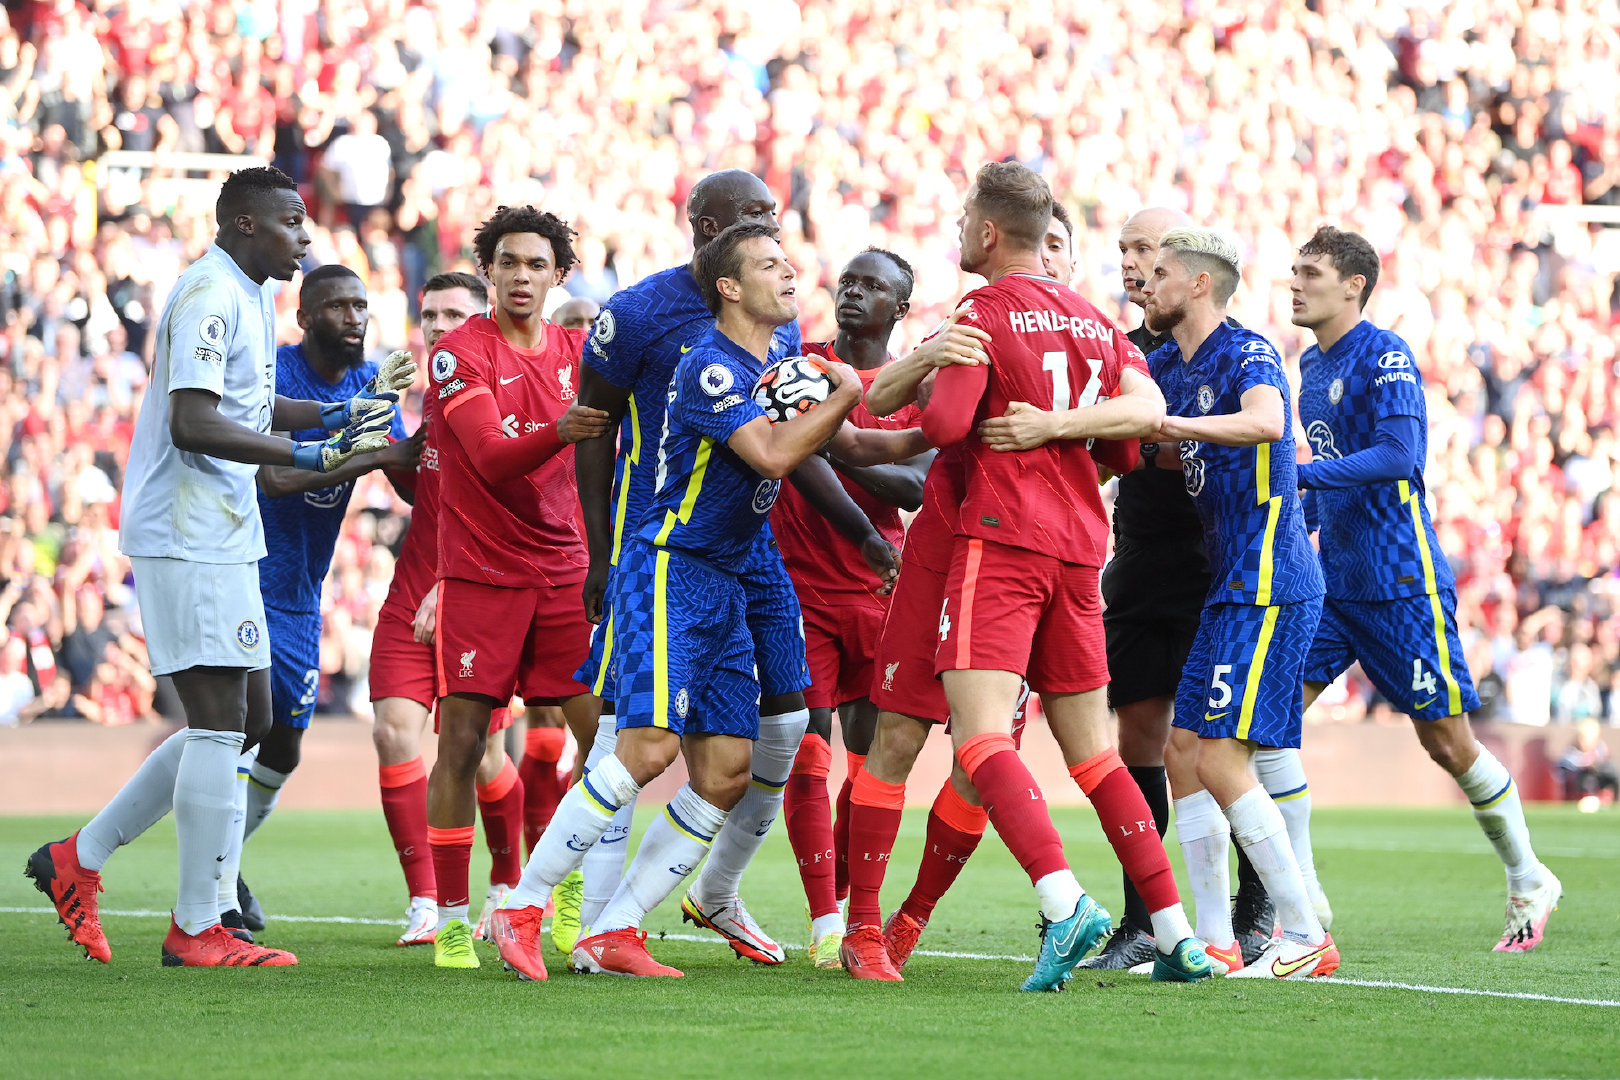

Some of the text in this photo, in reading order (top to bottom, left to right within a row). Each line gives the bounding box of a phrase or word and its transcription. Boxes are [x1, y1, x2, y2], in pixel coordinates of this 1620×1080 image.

[1208, 664, 1233, 709] 5
[1411, 658, 1437, 696] 4
[800, 849, 832, 867] LFC
